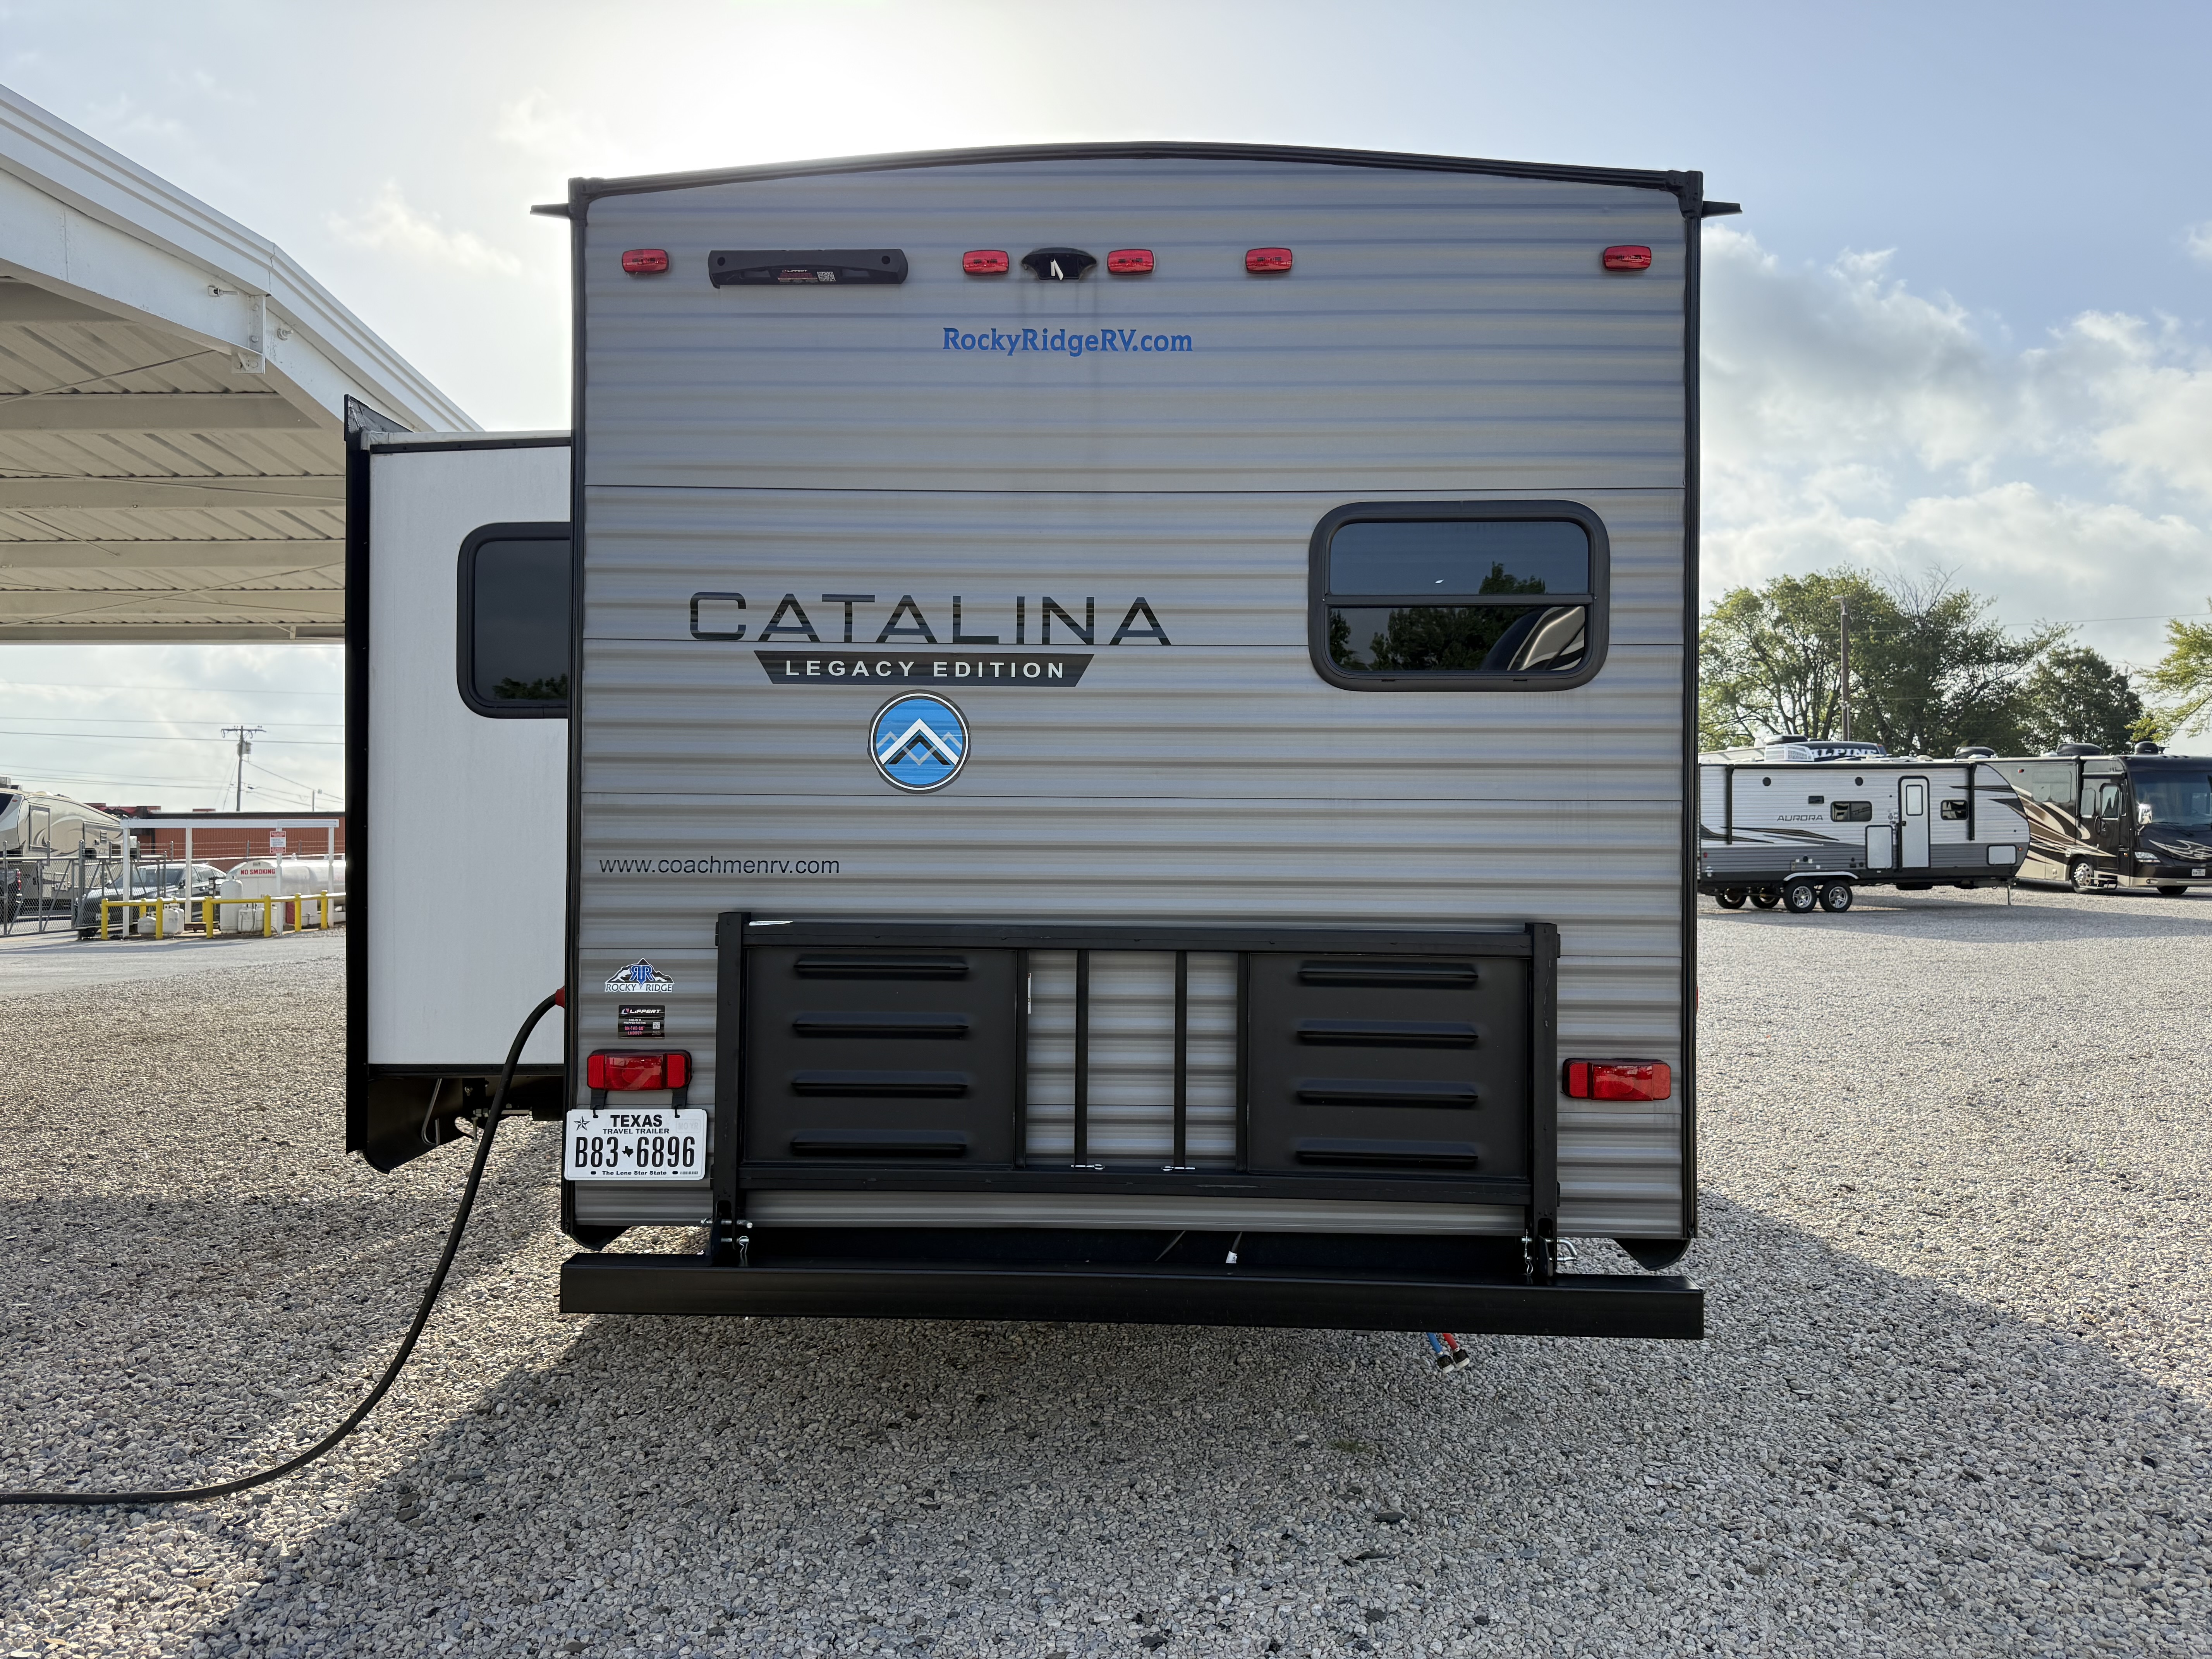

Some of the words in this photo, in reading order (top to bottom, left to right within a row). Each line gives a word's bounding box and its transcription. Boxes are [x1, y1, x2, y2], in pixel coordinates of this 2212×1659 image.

[943, 327, 1193, 357] RockyRidgeRV.com
[690, 592, 1172, 646] CATALINA
[786, 660, 914, 677] LEGACY
[933, 661, 1063, 678] EDITION
[599, 855, 840, 874] www.coachmenrv.com
[606, 983, 637, 991] ROCKY
[610, 1115, 662, 1127] TEXAS
[575, 1137, 618, 1168] B83
[636, 1136, 695, 1168] 6896
